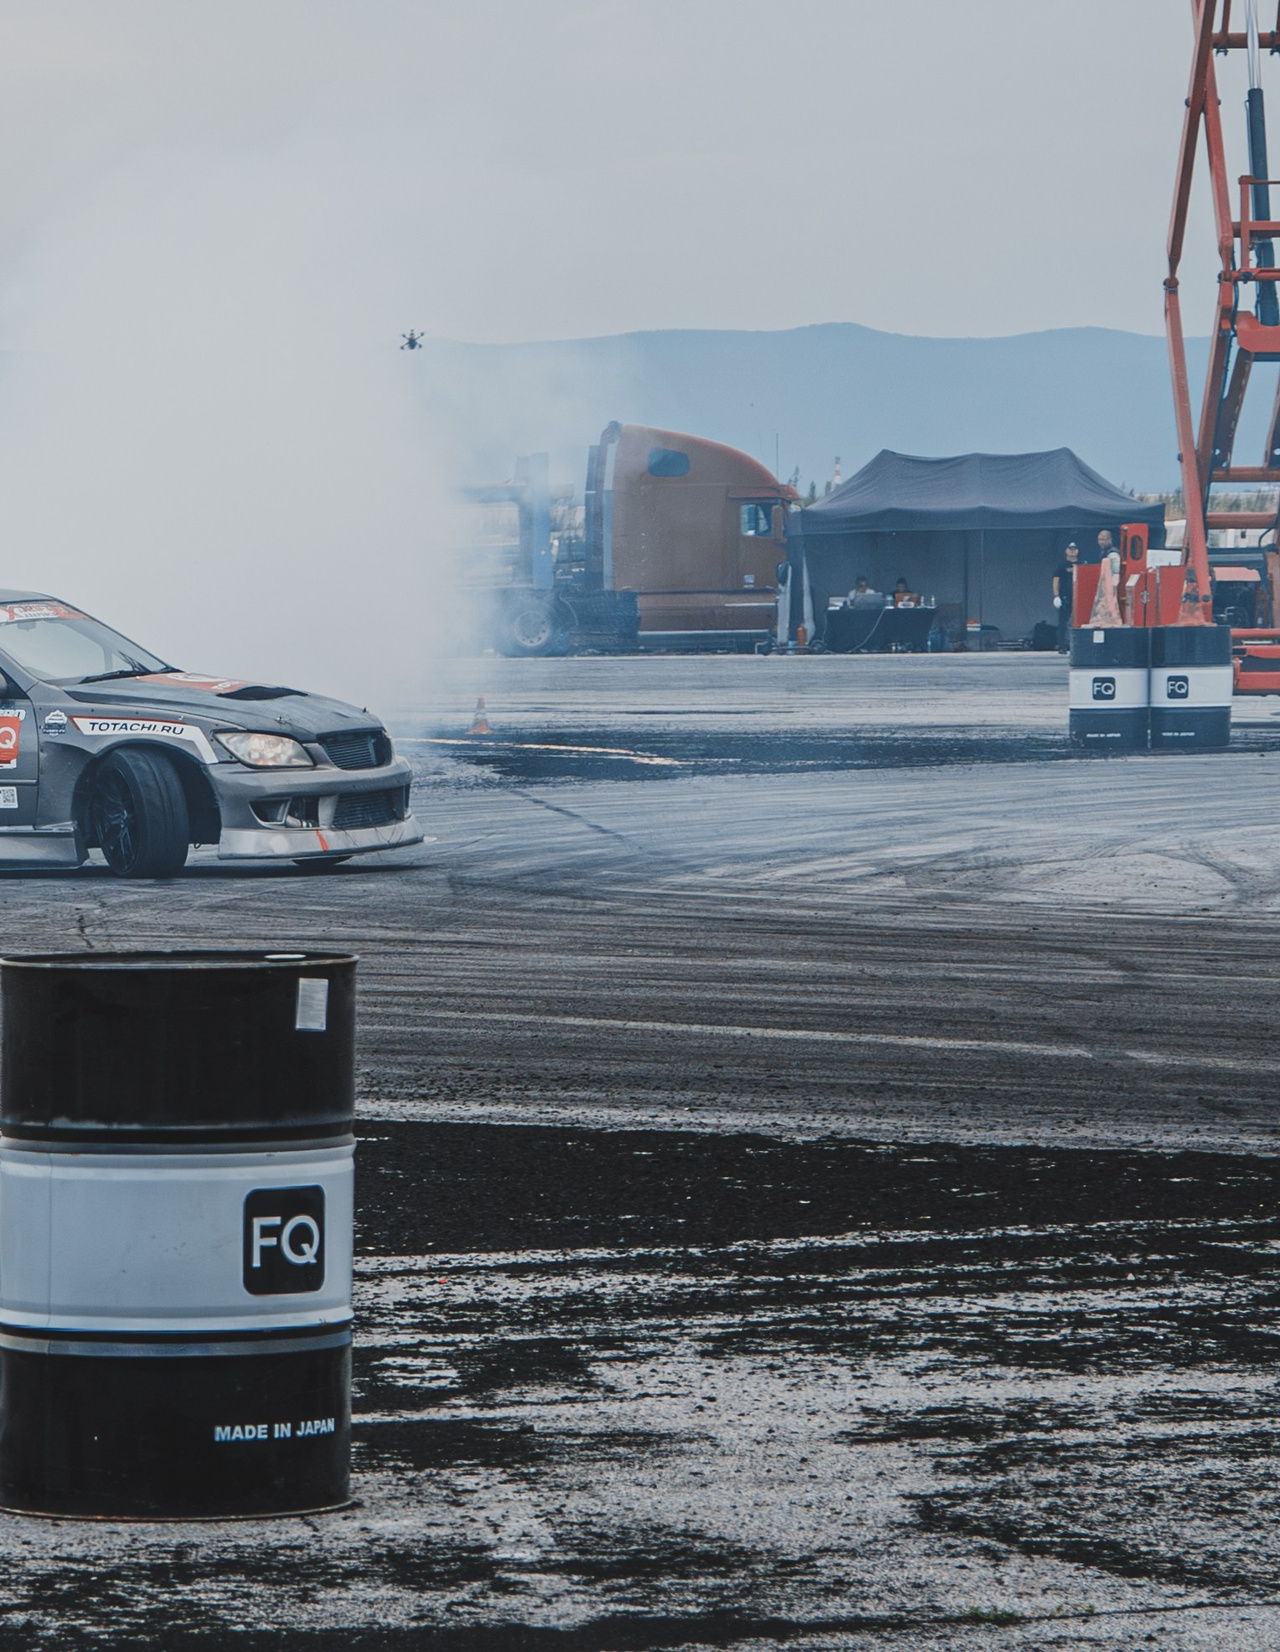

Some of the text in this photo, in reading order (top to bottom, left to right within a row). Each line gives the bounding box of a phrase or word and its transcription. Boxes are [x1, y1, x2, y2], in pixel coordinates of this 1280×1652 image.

[1093, 682, 1115, 695] FQ
[1167, 681, 1188, 694] FQ
[89, 722, 185, 735] TOTACHI.RU
[252, 1214, 320, 1268] FQ
[214, 1418, 335, 1441] MADE IN JAPAN
